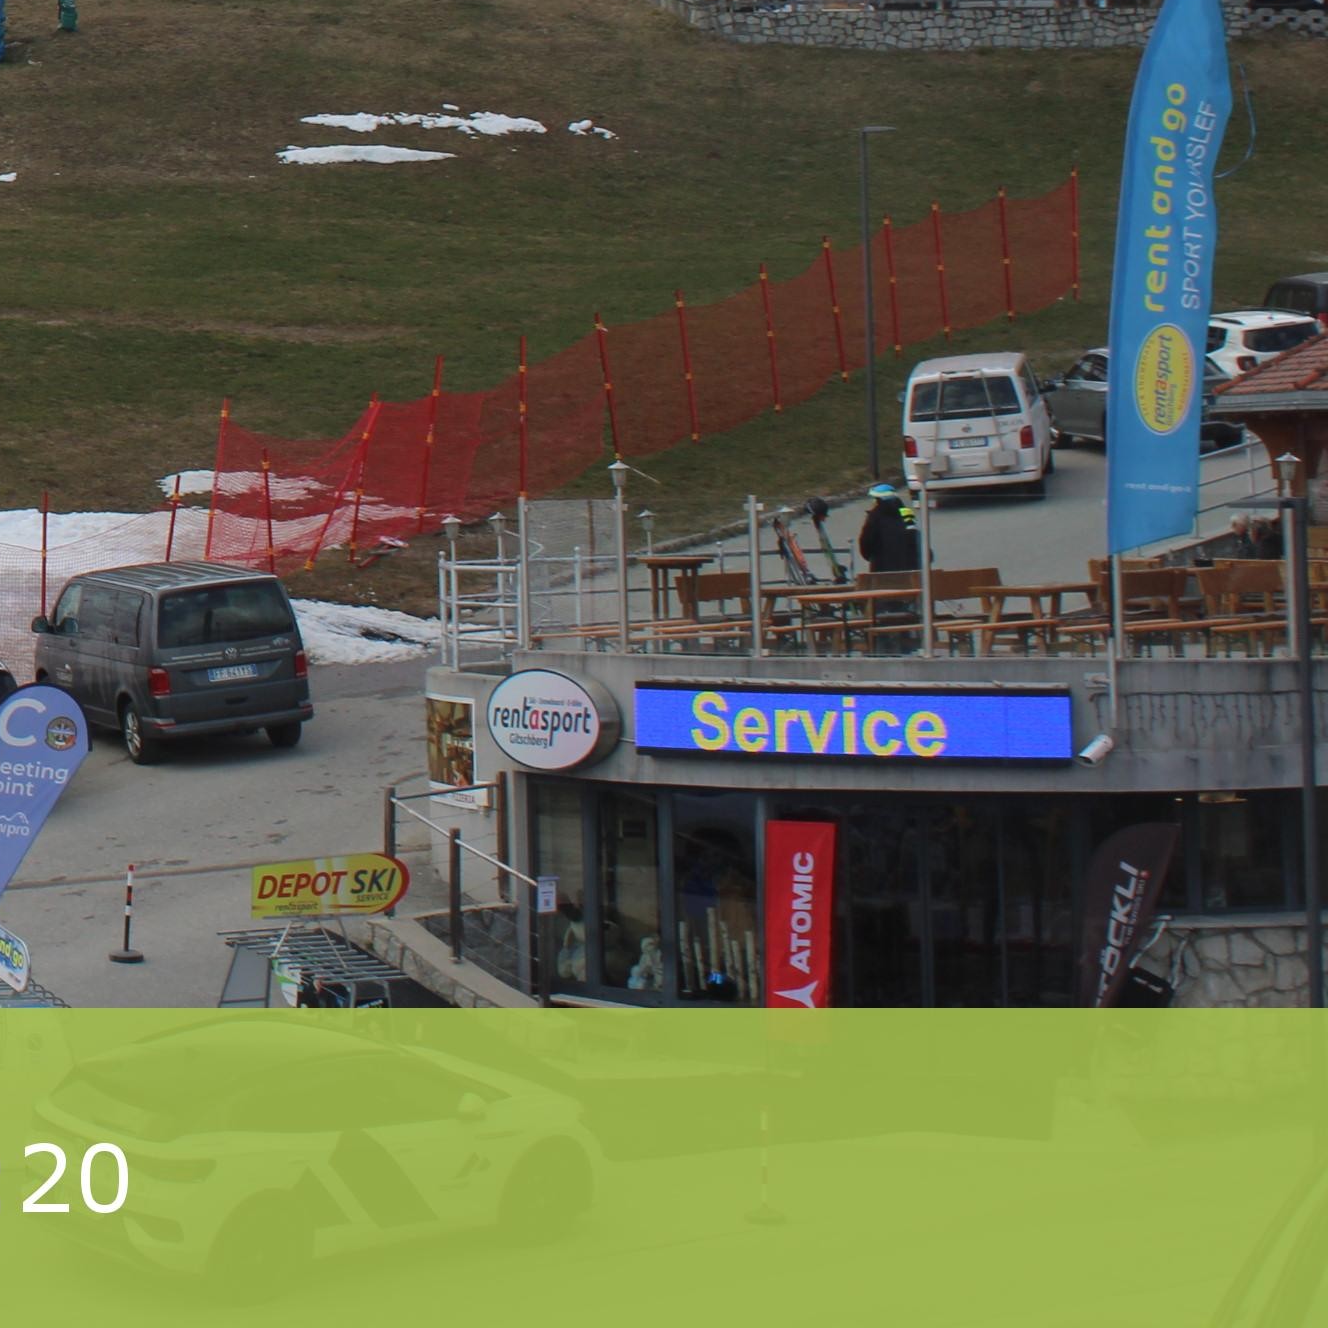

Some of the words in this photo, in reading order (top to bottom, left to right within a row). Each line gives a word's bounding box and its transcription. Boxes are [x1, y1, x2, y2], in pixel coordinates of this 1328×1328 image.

[1162, 83, 1188, 134] go
[1150, 136, 1177, 215] and
[1144, 224, 1171, 312] rent
[1181, 225, 1204, 310] SPORT
[1153, 333, 1173, 426] rentasport
[493, 696, 592, 747] rentasport
[509, 732, 548, 749] Gitschberg
[691, 691, 947, 757] Service
[257, 871, 348, 900] DEPOT
[350, 867, 397, 894] SKI
[789, 852, 815, 975] ATOMIC
[11, 948, 25, 968] go
